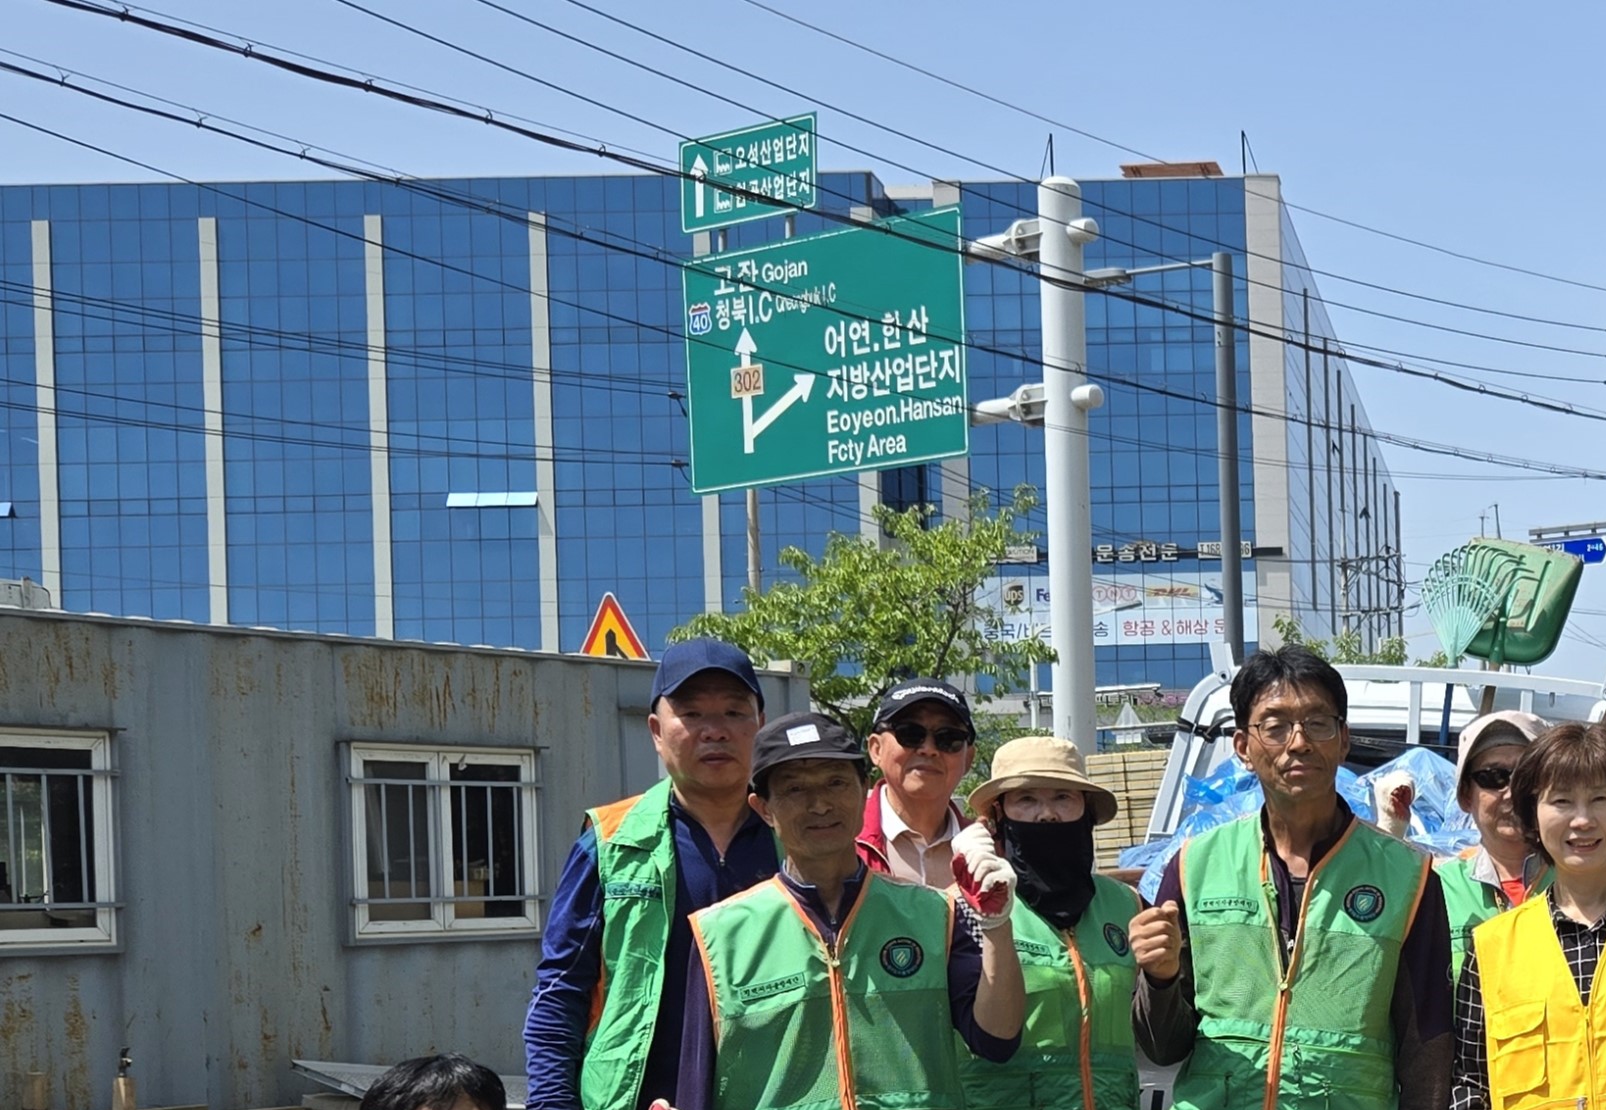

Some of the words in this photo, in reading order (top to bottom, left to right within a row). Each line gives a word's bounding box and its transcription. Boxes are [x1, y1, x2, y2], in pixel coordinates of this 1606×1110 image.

[735, 131, 810, 169] 오성산업단지
[714, 259, 758, 296] 고잔
[761, 259, 808, 284] Gojan
[692, 314, 708, 331] 40
[734, 369, 762, 393] 302
[826, 345, 960, 402] 지방산업단지
[827, 439, 864, 466] Fcty
[867, 434, 907, 458] Area
[1004, 589, 1024, 604] ups
[1093, 587, 1136, 600] TNT
[1152, 587, 1193, 597] DHL
[1123, 620, 1156, 637] 항공
[1161, 620, 1174, 635] &
[1176, 620, 1209, 635] 해상
